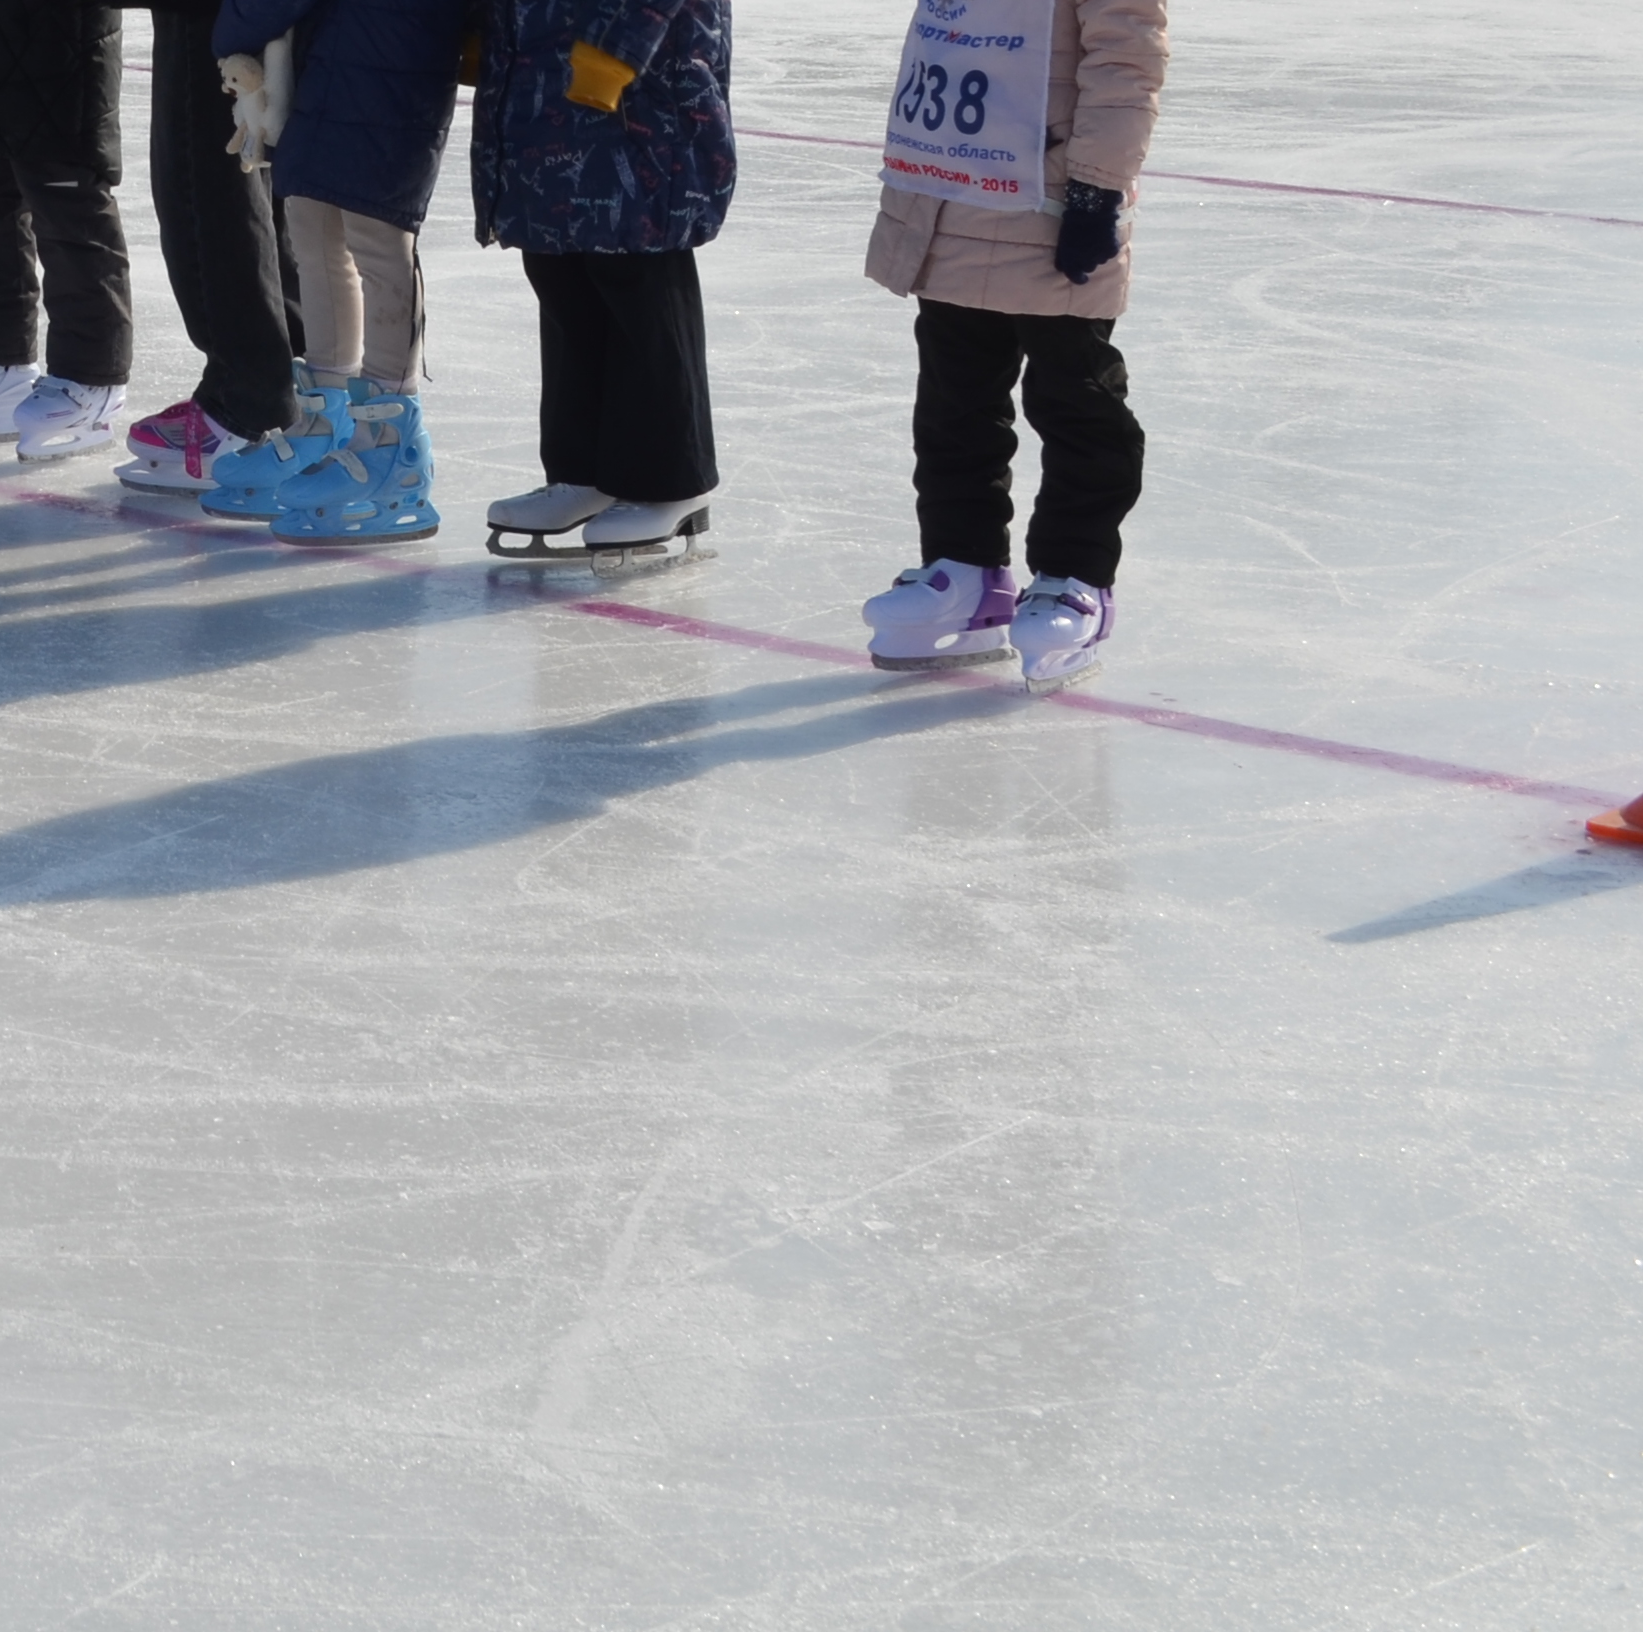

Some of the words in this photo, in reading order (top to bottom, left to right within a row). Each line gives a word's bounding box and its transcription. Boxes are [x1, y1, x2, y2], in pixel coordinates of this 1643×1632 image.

[895, 57, 989, 135] 1538
[947, 138, 1016, 163] область
[923, 164, 971, 185] РОССИИ
[981, 178, 1019, 194] 2015
